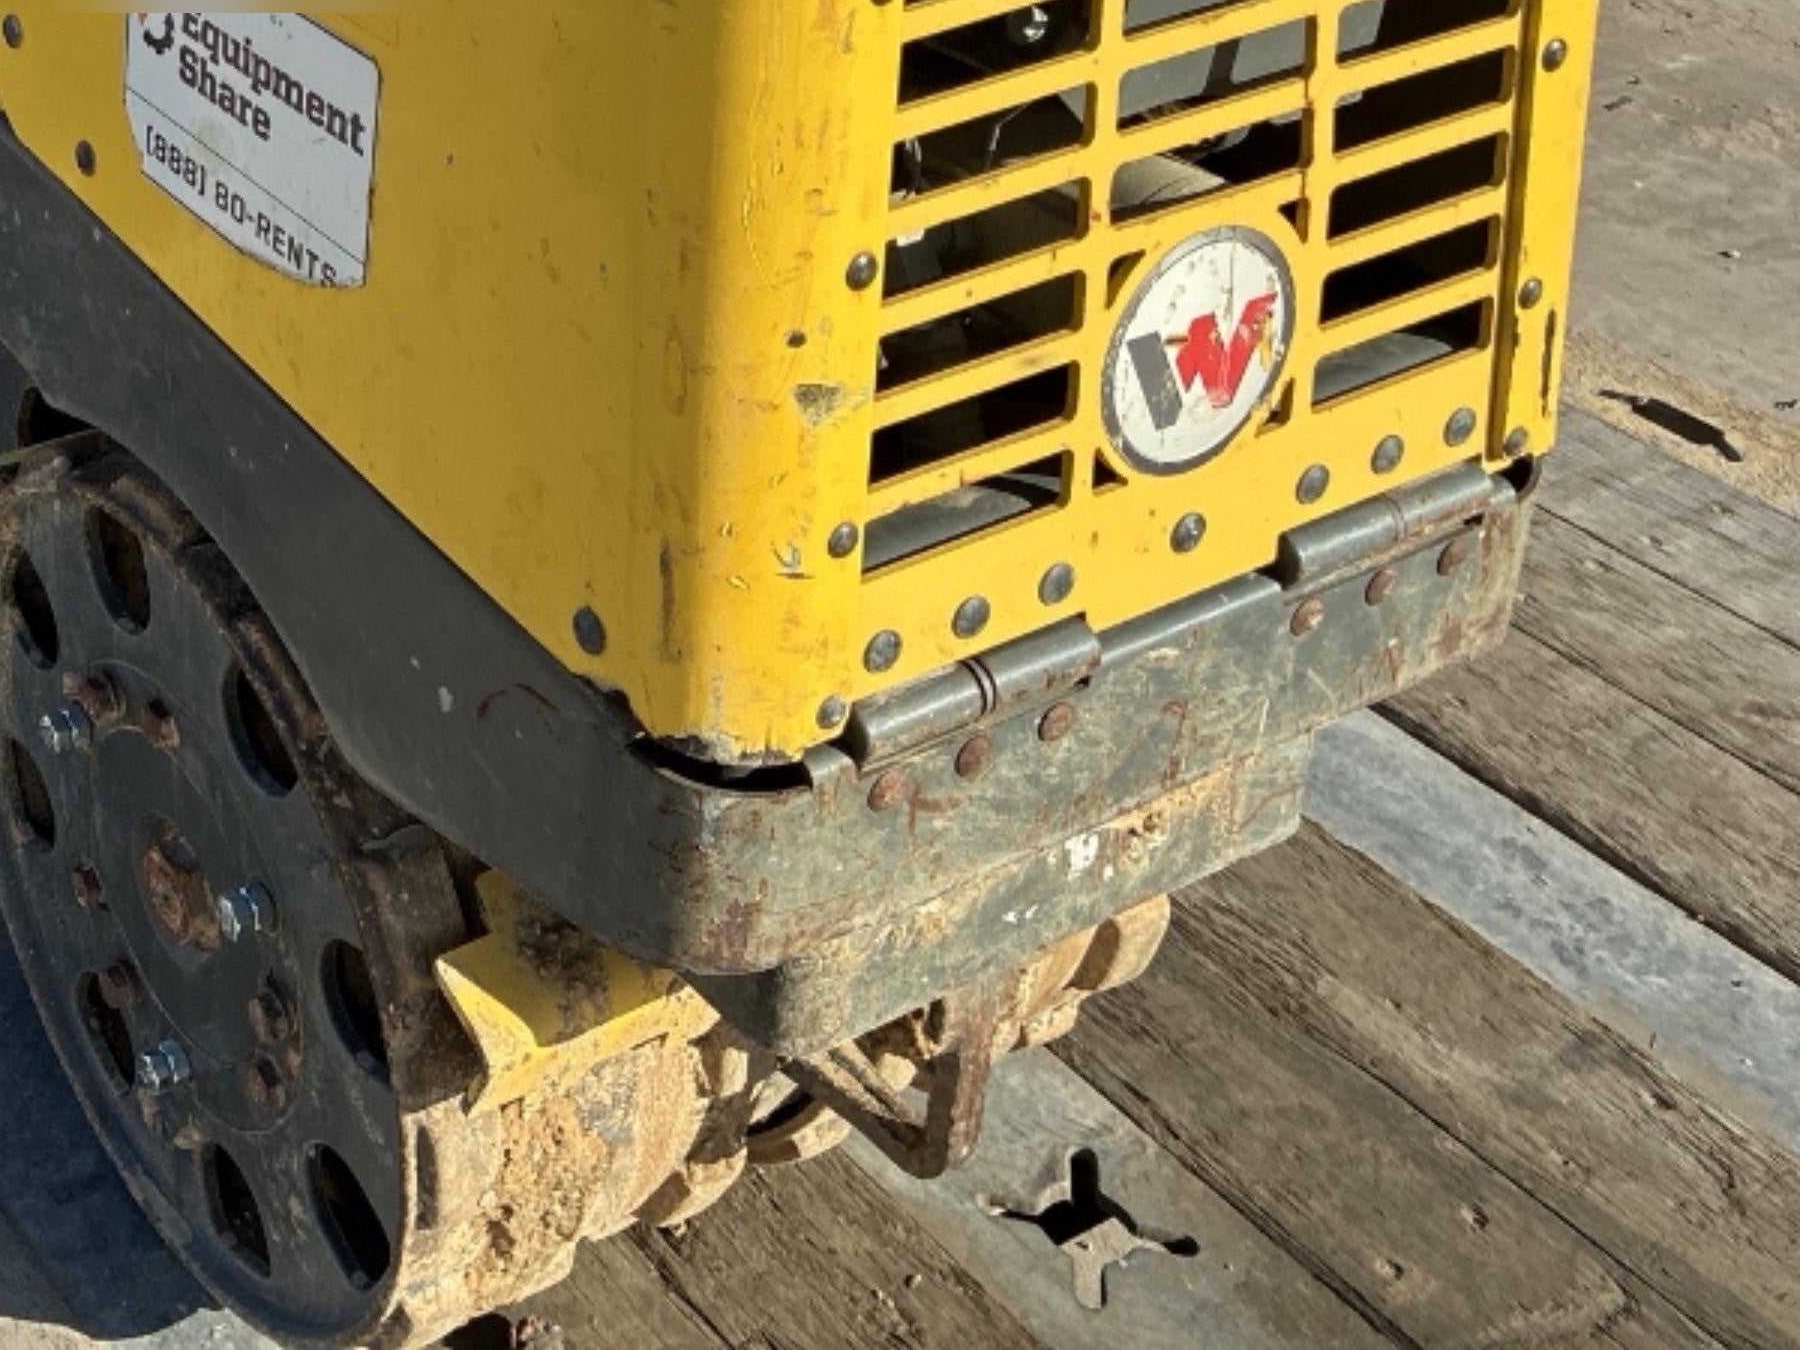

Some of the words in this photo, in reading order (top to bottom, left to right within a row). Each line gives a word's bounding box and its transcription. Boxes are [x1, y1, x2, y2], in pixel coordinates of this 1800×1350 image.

[178, 45, 272, 142] Share
[181, 13, 366, 157] Equipment
[215, 179, 337, 287] 80-RENTS
